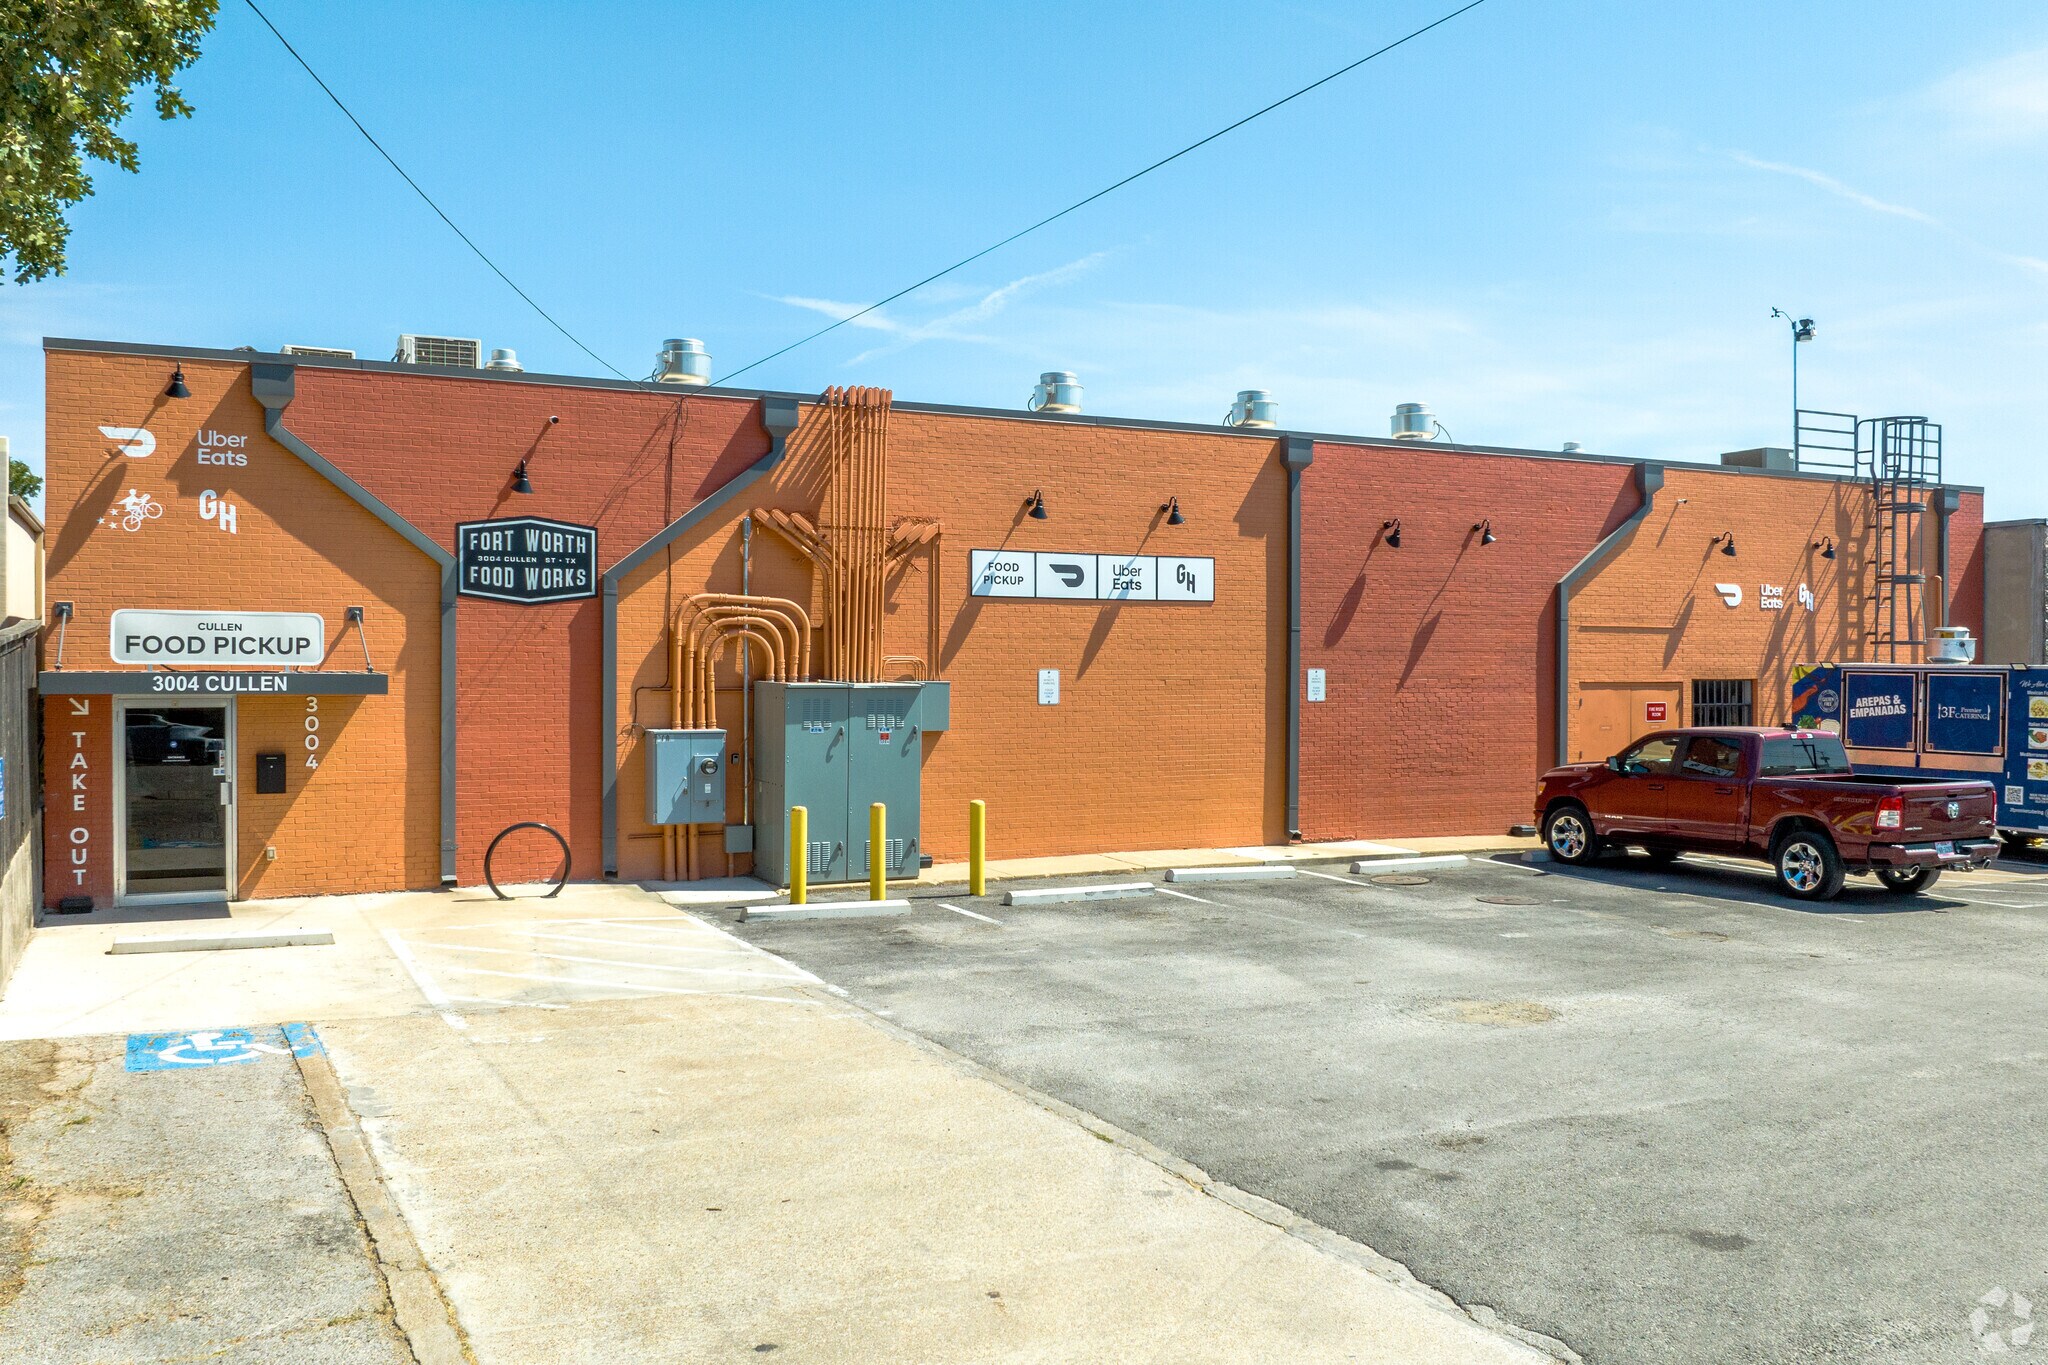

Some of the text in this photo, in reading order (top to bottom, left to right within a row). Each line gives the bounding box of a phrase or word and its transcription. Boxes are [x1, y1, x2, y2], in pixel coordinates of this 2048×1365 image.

[197, 429, 248, 447] Uber
[197, 448, 248, 467] Eats
[199, 489, 237, 535] GH
[470, 529, 586, 553] FORT WORTH
[988, 562, 1020, 573] FOOD
[1112, 564, 1142, 577] Uber
[470, 566, 586, 590] FOOD WORKS
[983, 575, 1024, 586] PICKUP
[1112, 578, 1142, 591] Eats
[1176, 563, 1196, 594] GH
[1761, 584, 1783, 596] Uber
[1799, 583, 1814, 611] GH
[1761, 597, 1783, 609] Eats
[197, 621, 243, 632] CULLEN
[125, 635, 311, 655] FOOD PICKUP
[152, 675, 288, 692] 3004 CULLEN
[1856, 694, 1901, 708] AREPAS &
[1850, 704, 1907, 719] EMPANADAS
[1941, 706, 1956, 718] 3F
[304, 696, 319, 770] 3004
[70, 732, 90, 886] TAKE OUT
